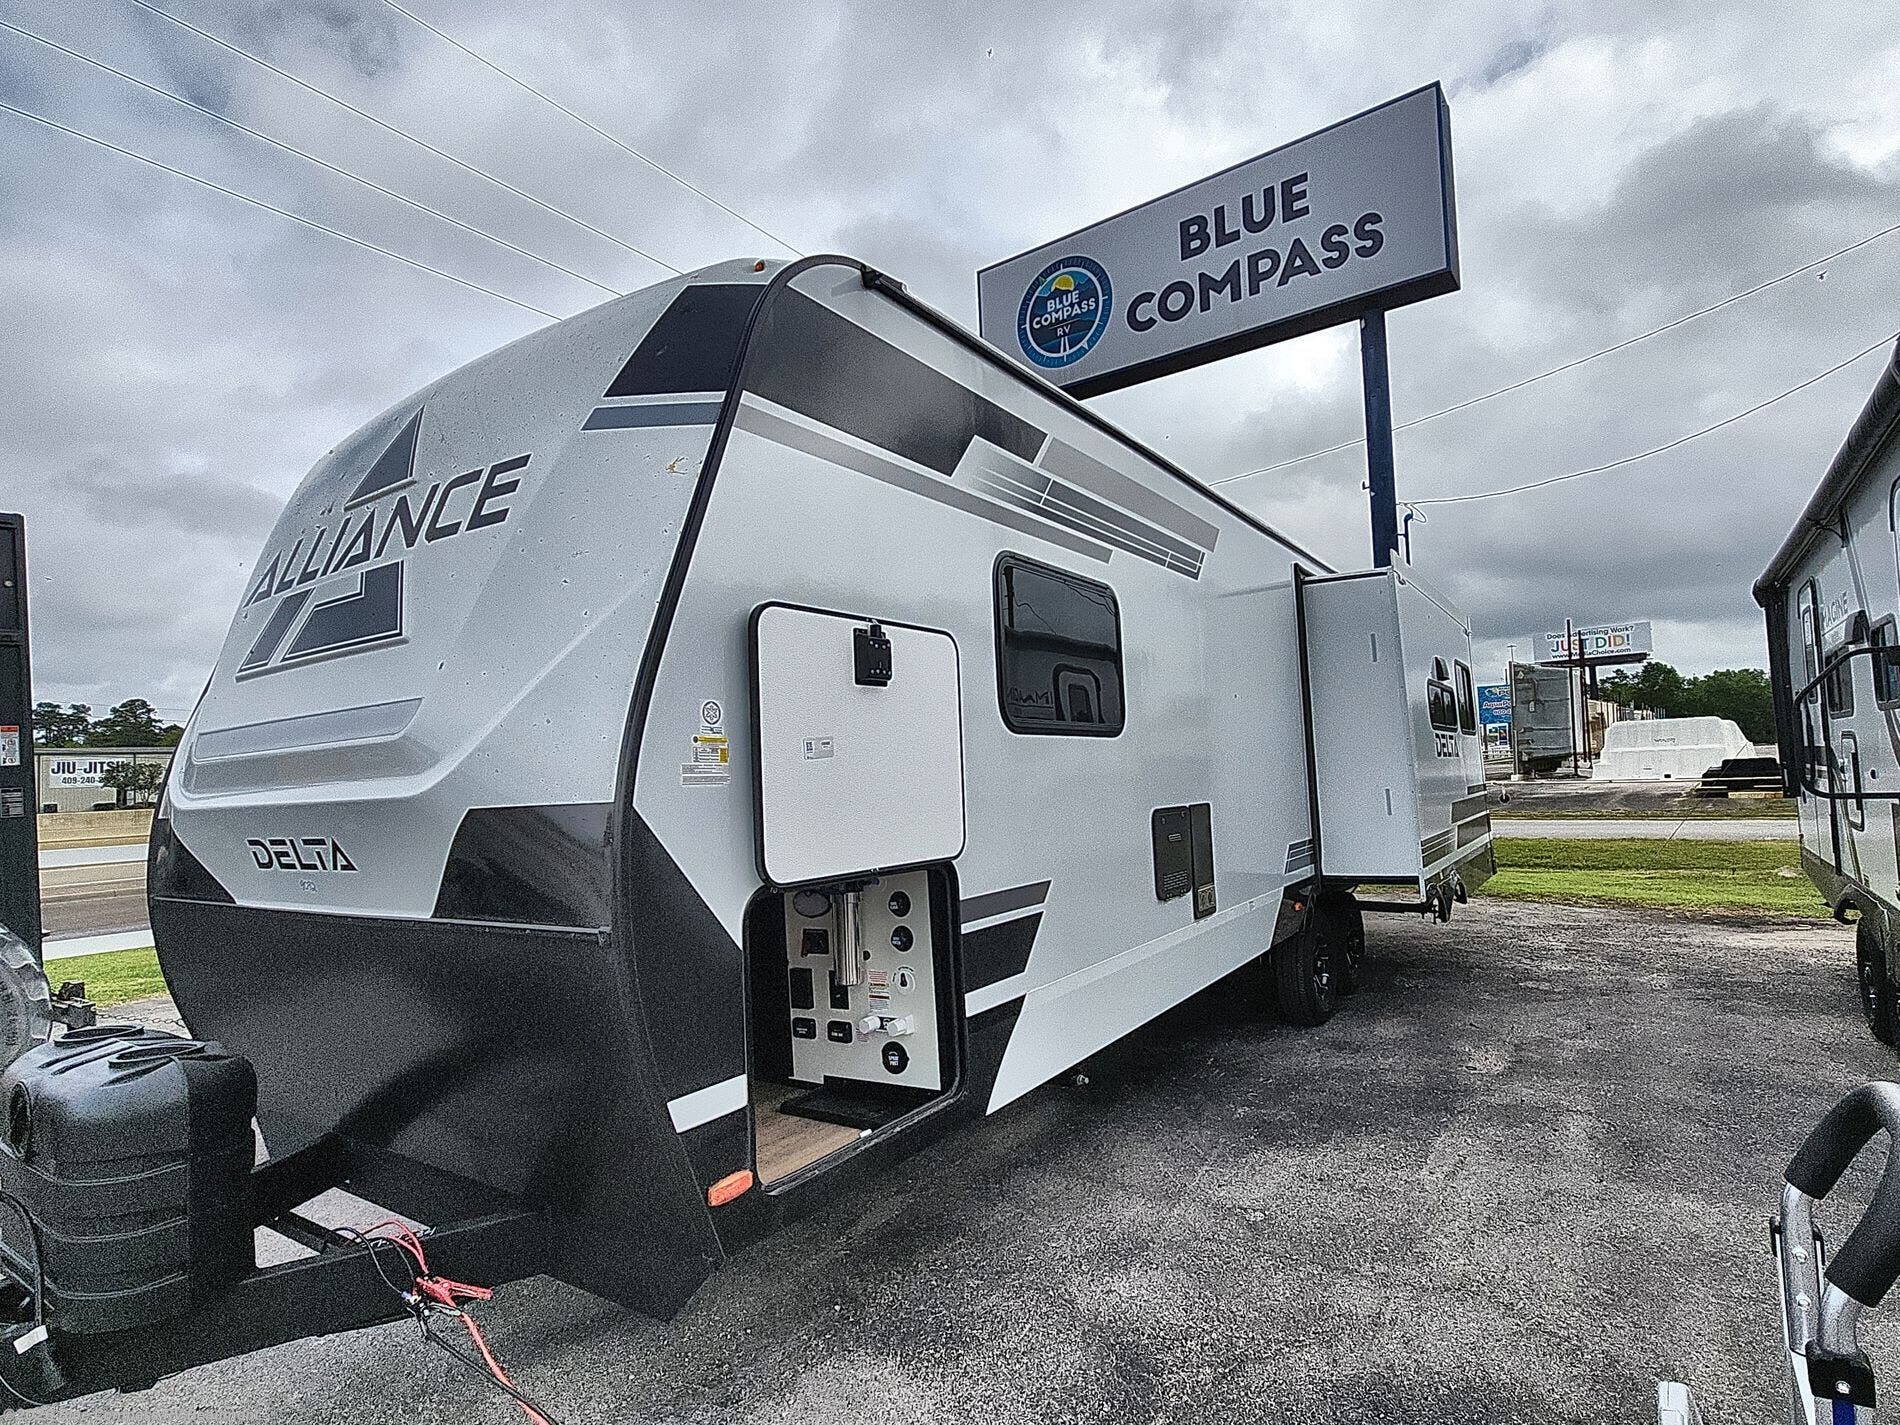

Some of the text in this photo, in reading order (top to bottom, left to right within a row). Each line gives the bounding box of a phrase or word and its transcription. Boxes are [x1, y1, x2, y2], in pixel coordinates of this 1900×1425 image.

[1179, 172, 1310, 261] BLUE
[1126, 212, 1384, 332] COMPASS
[1032, 298, 1096, 329] COMPASS
[1047, 290, 1080, 312] BLUE
[1057, 325, 1071, 336] RV
[242, 452, 532, 608] ALLIANCE
[1551, 634, 1630, 652] JUST DID!
[1567, 628, 1609, 639] dertising
[1610, 626, 1634, 634] Work?
[1434, 733, 1460, 757] DELTA
[246, 836, 358, 871] DELTA
